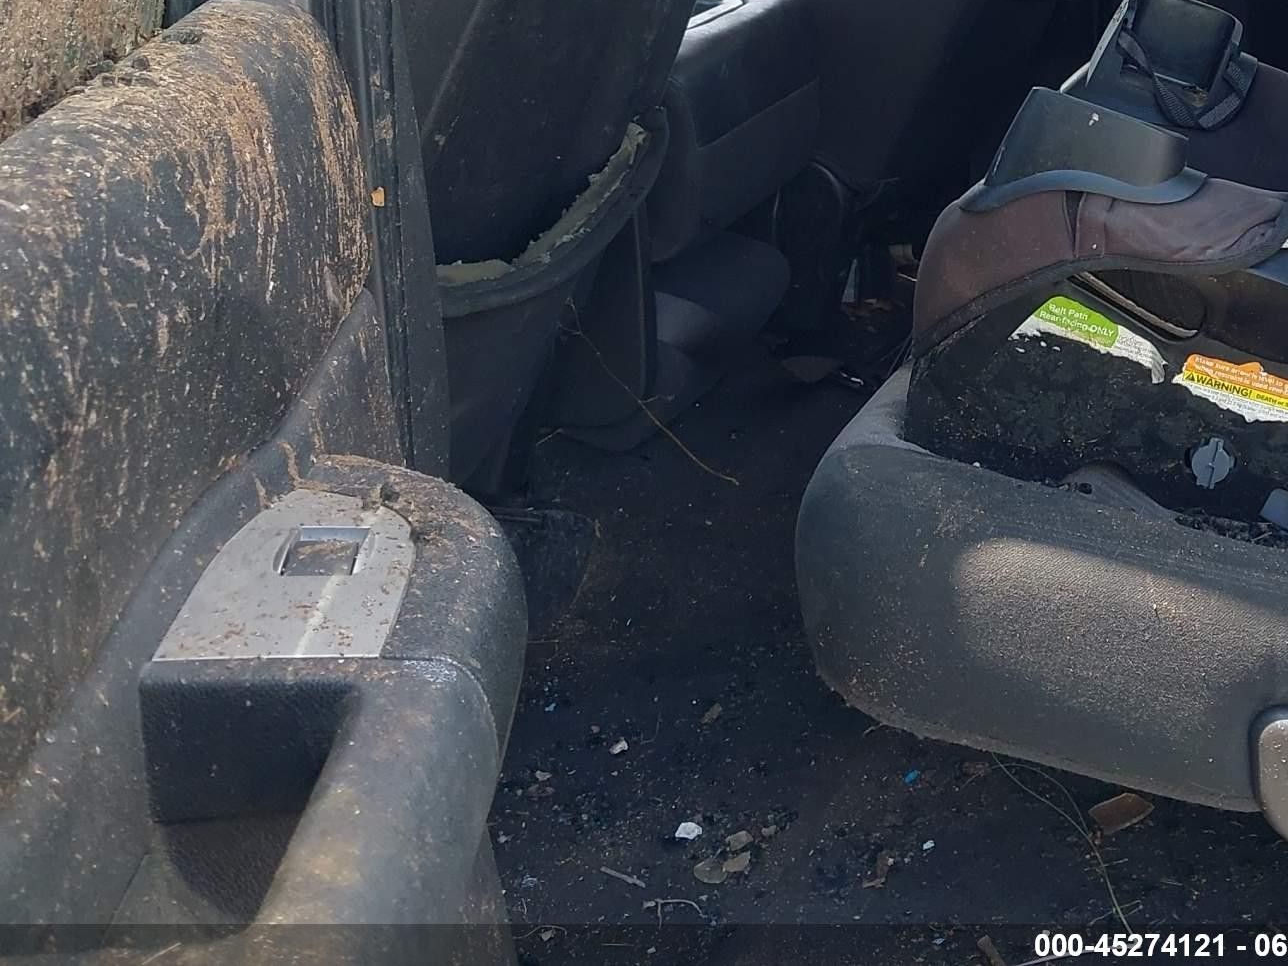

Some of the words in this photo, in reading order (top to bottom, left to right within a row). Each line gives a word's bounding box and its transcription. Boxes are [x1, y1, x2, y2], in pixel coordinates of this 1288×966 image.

[1039, 310, 1088, 331] Rear-facing
[1089, 325, 1115, 337] ONLY
[1049, 303, 1067, 315] Belt
[1068, 309, 1089, 321] Path
[1195, 356, 1214, 367] Make
[1215, 363, 1230, 372] sure
[1231, 368, 1251, 377] arrow
[1258, 374, 1275, 384] level
[1276, 379, 1283, 387] to
[1252, 380, 1268, 389] used
[1196, 373, 1253, 397] WARNING!
[1256, 393, 1278, 405] DEATH
